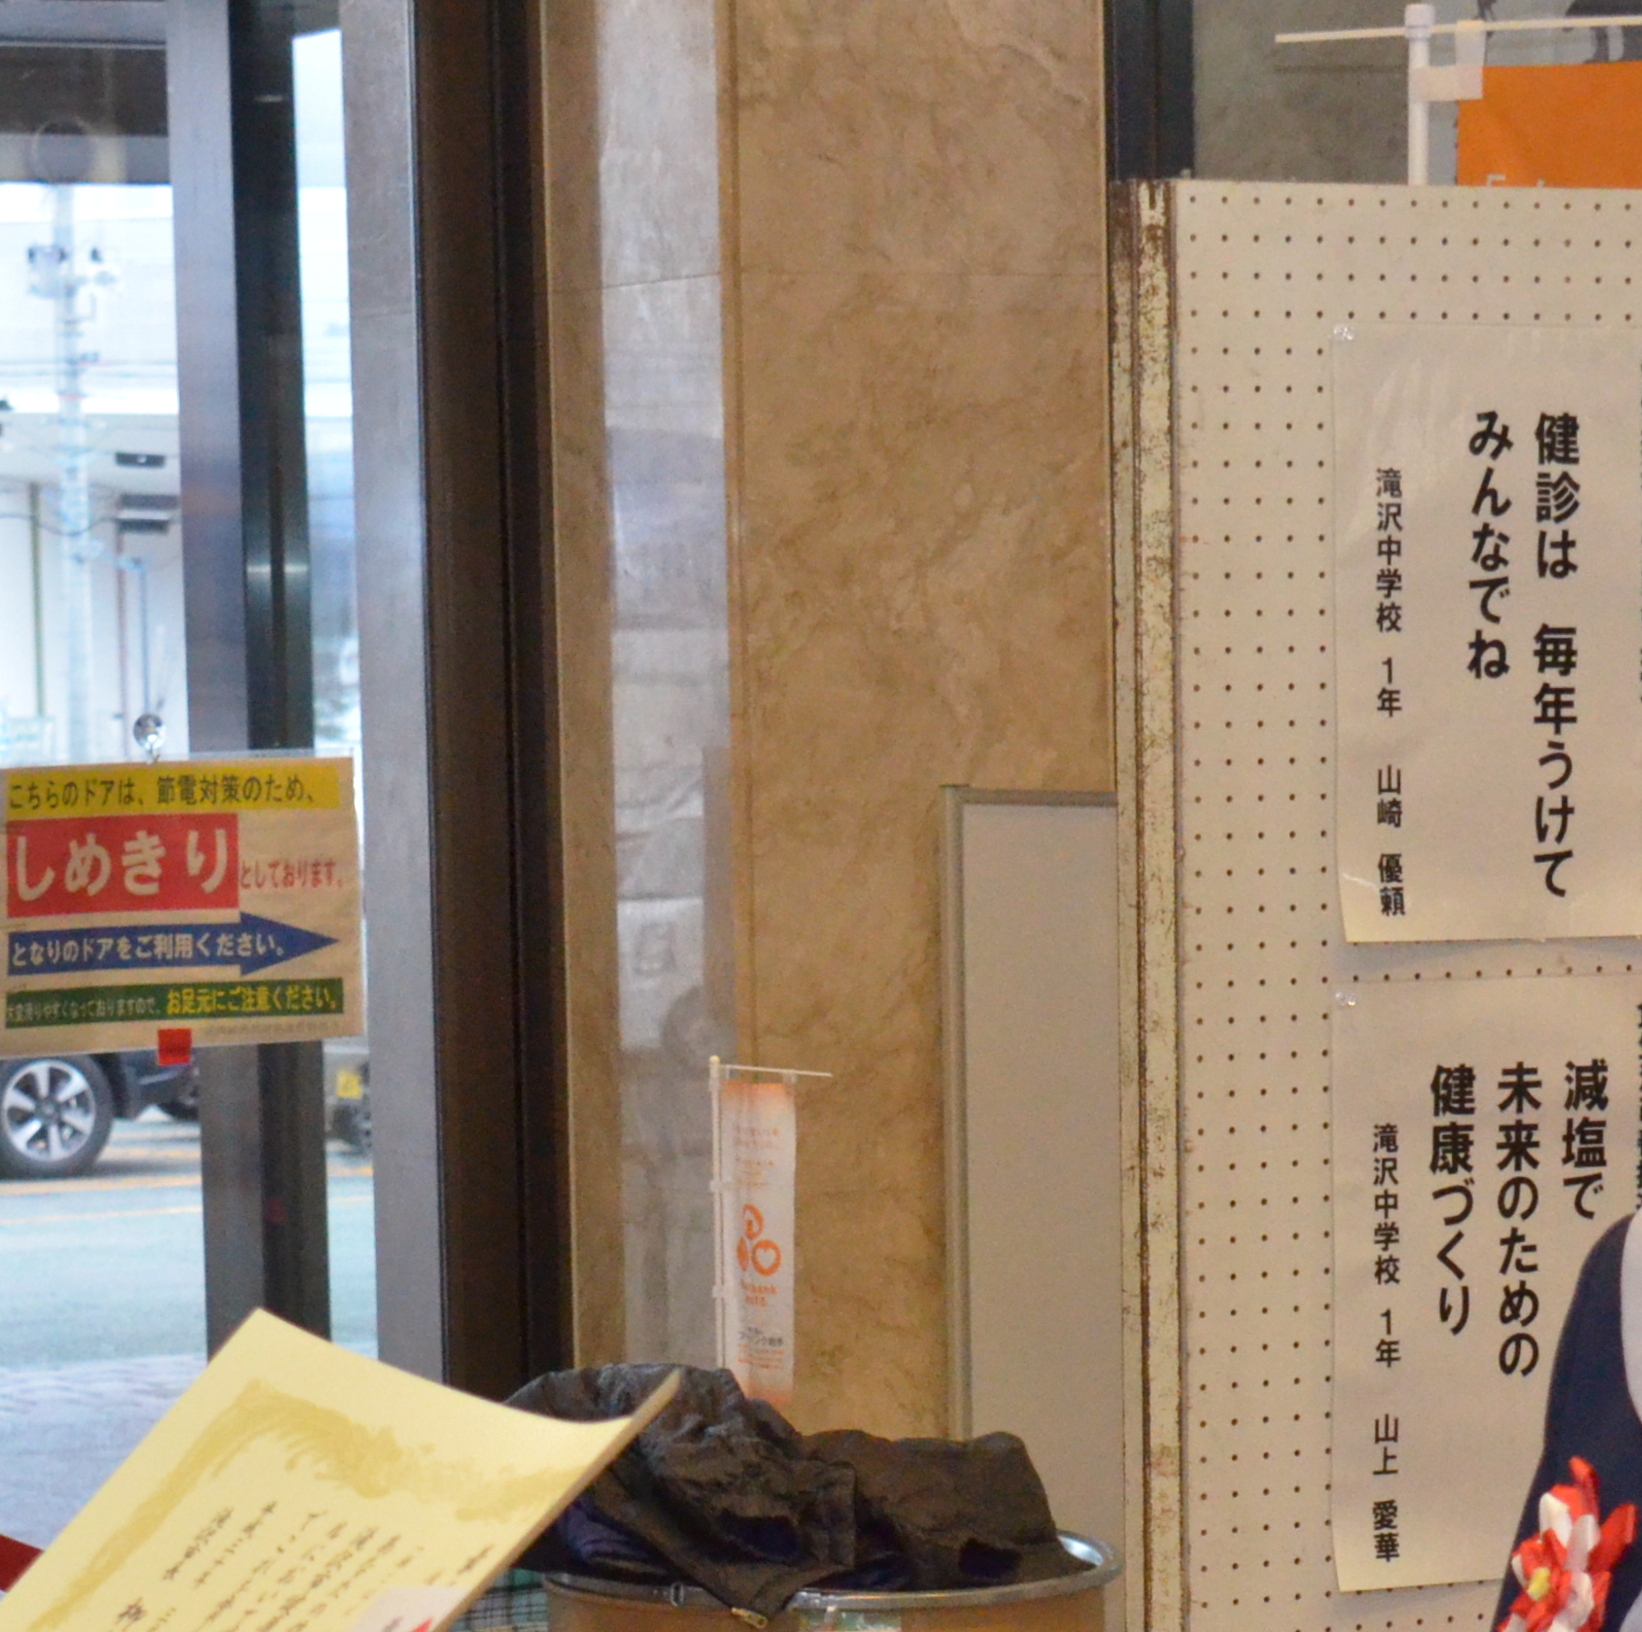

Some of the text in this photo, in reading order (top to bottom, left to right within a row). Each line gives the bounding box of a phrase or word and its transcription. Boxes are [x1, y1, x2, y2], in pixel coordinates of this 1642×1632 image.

[1375, 467, 1403, 634] 滝沢中学校
[1467, 409, 1513, 679] みんなでね
[1377, 656, 1403, 718] 1年
[1532, 411, 1581, 899] 健診は 毎年うけて
[8, 773, 315, 810] こちらのドアは、節電対策のため、
[15, 828, 346, 901] しめきり としております。
[1376, 764, 1403, 828] 山崎
[11, 930, 285, 967] となりのドアをご利用ください。
[1428, 1064, 1476, 1337] 健康づくり
[1495, 1060, 1543, 1378] 未来のための
[1562, 1058, 1608, 1221] 減塩で
[1372, 1122, 1401, 1563] 滝沢中学校 1年 山上 愛華
